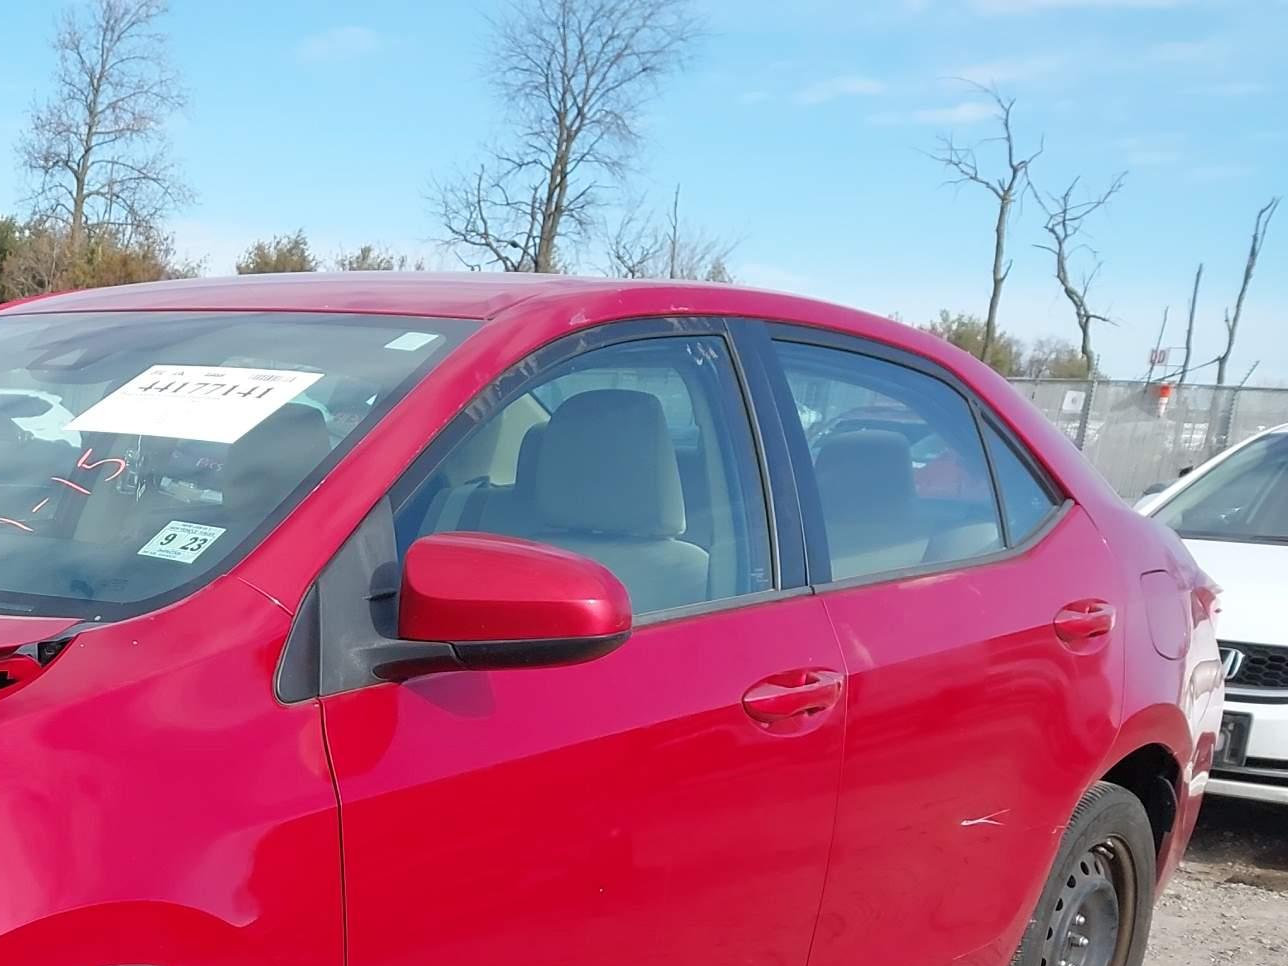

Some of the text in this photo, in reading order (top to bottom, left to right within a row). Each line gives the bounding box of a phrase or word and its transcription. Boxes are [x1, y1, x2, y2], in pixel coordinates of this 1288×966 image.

[137, 381, 275, 399] 44177141
[159, 533, 209, 552] 9 23
